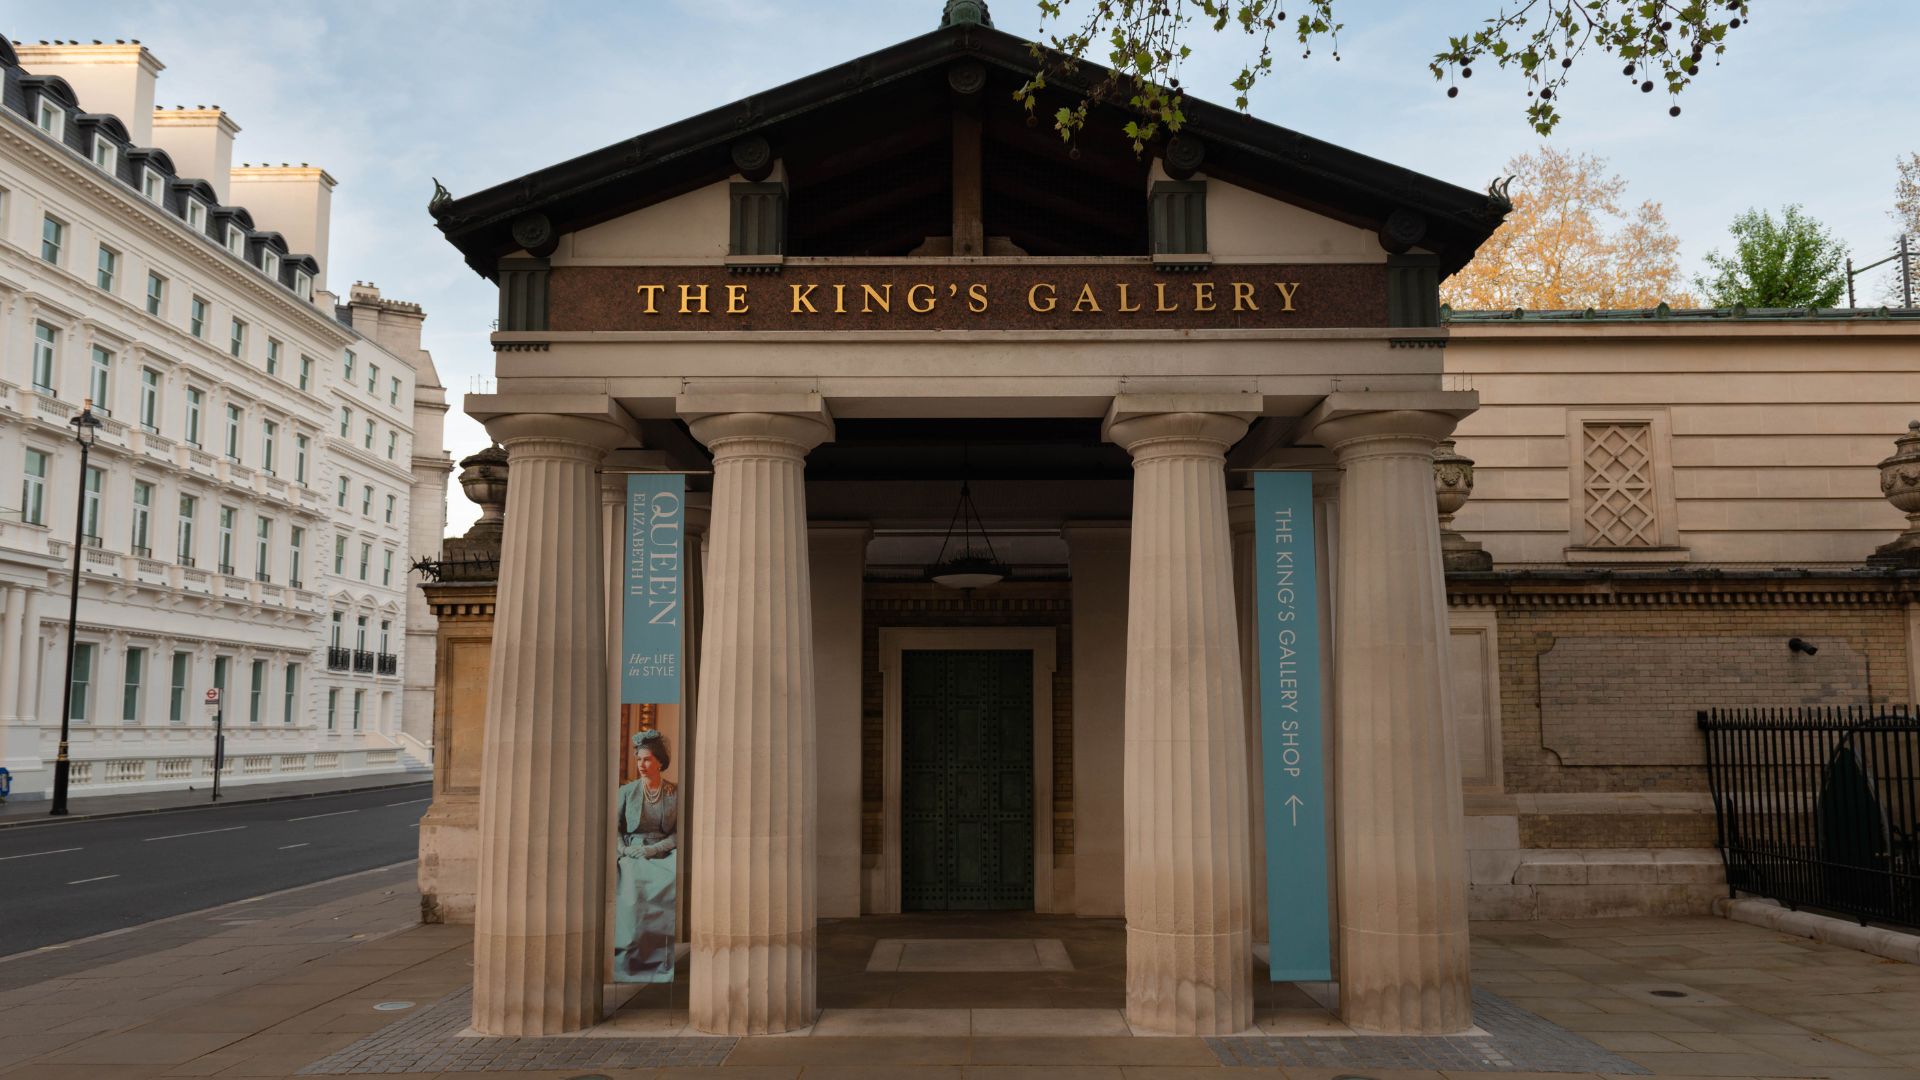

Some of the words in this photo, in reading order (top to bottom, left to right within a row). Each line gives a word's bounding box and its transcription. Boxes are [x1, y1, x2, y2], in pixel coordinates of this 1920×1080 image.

[637, 283, 749, 314] THE
[789, 283, 989, 313] KING'S
[1027, 282, 1301, 313] GALLERY
[631, 493, 646, 579] ELIZABETH
[1275, 508, 1292, 544] THE
[648, 491, 679, 626] QUEEN
[630, 585, 643, 596] II
[1277, 551, 1295, 622] KING'S
[628, 665, 640, 676] in
[643, 665, 675, 676] STYLE
[629, 653, 650, 665] Her
[654, 653, 676, 665] LIFE
[1279, 629, 1298, 713] GALLERY
[1282, 720, 1300, 777] SHOP
